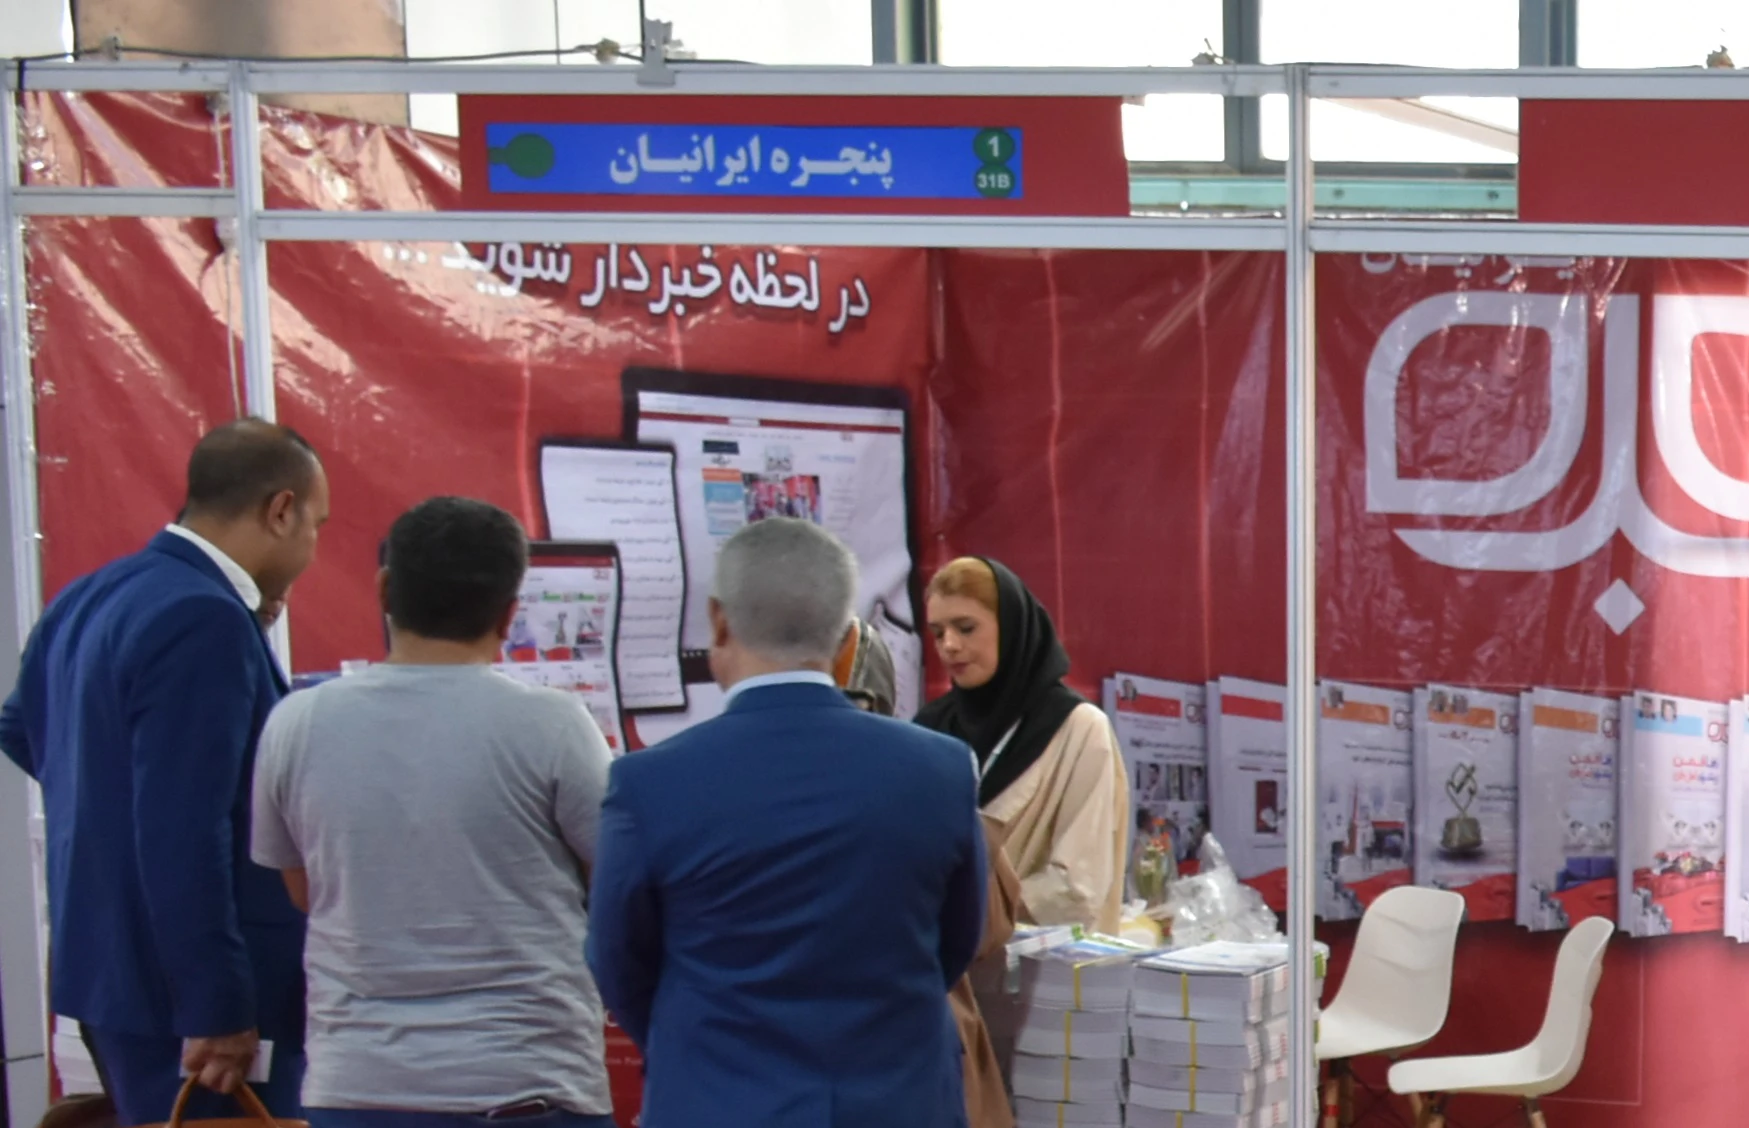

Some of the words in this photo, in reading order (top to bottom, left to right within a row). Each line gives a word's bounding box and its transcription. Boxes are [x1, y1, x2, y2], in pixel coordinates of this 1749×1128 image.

[609, 132, 761, 185] ایرانیان
[770, 141, 894, 190] پنجره
[987, 135, 1000, 158] 1
[977, 172, 1011, 189] 31B
[729, 251, 820, 312] لحظه
[828, 278, 870, 333] در
